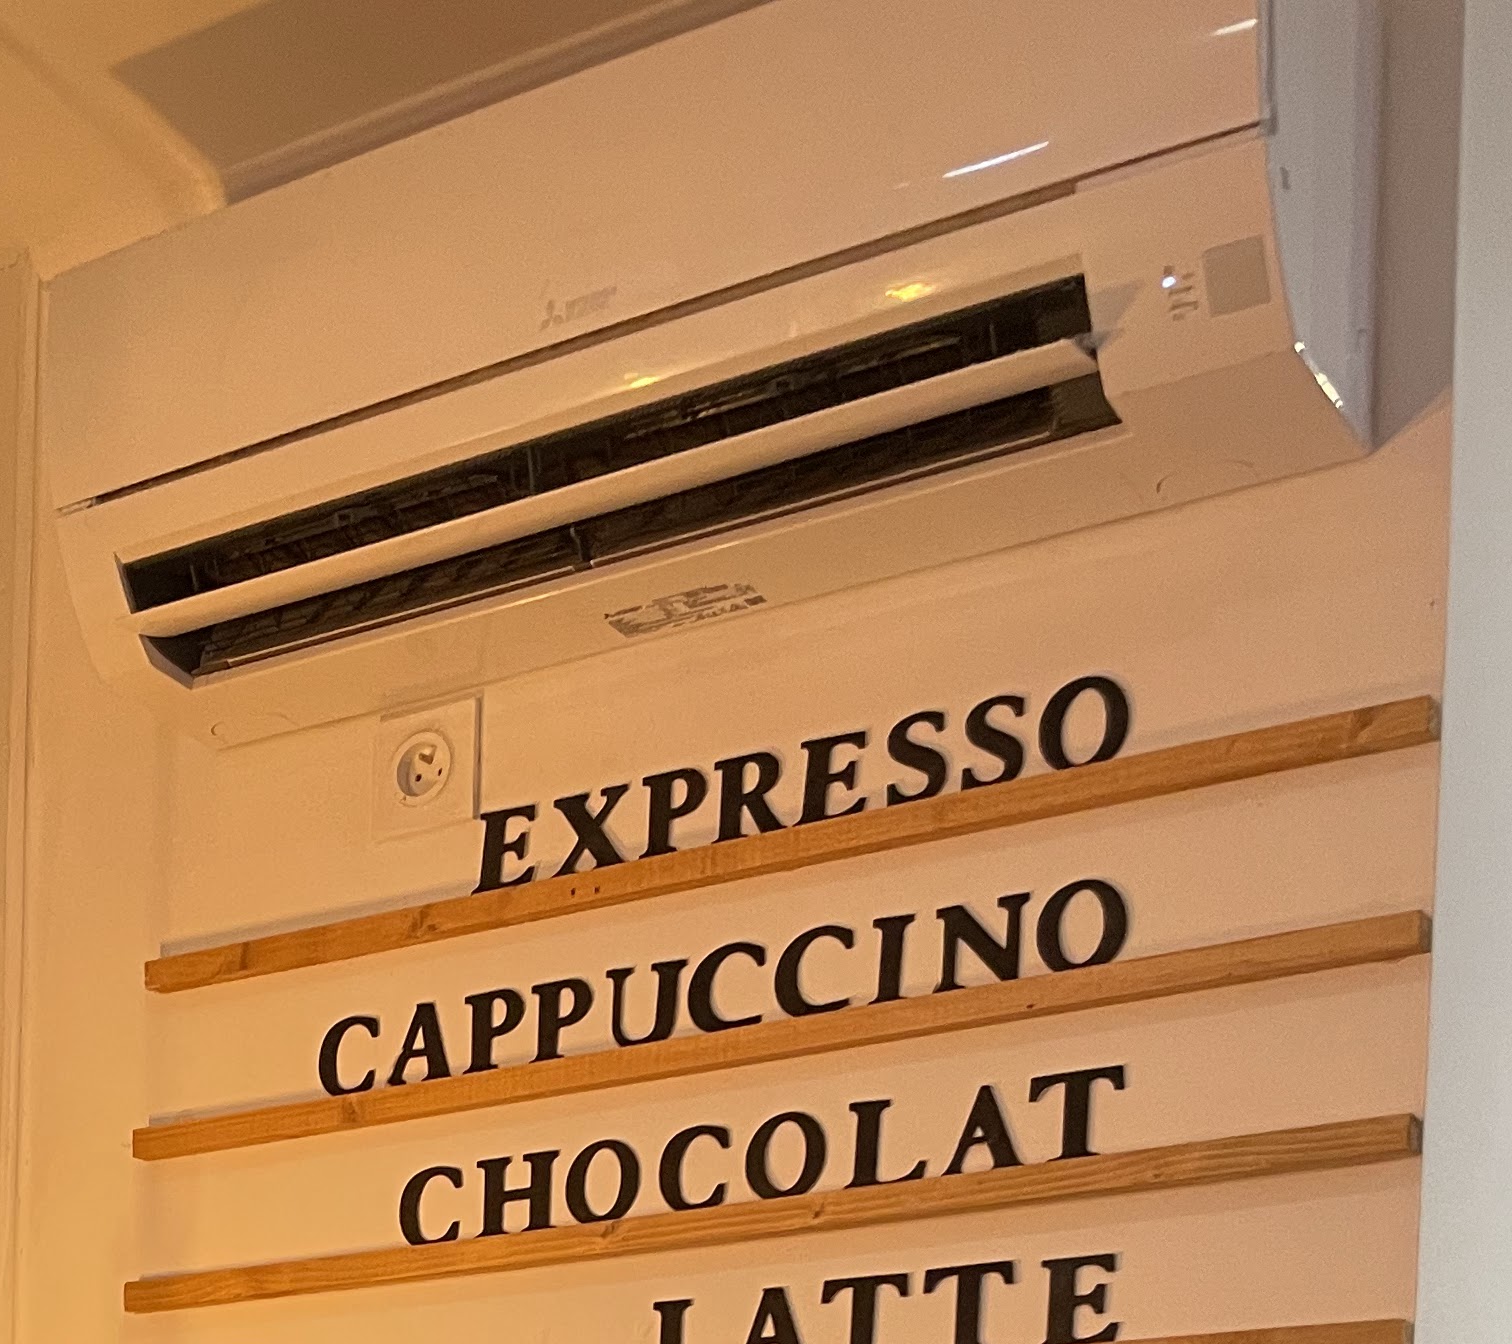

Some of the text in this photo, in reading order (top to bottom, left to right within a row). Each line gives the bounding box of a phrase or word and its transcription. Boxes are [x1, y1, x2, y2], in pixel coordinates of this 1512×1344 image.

[470, 675, 1131, 897] EXPRESSO
[317, 878, 1129, 1098] CAPPUCCINO
[398, 1063, 1127, 1247] CHOCOLAT
